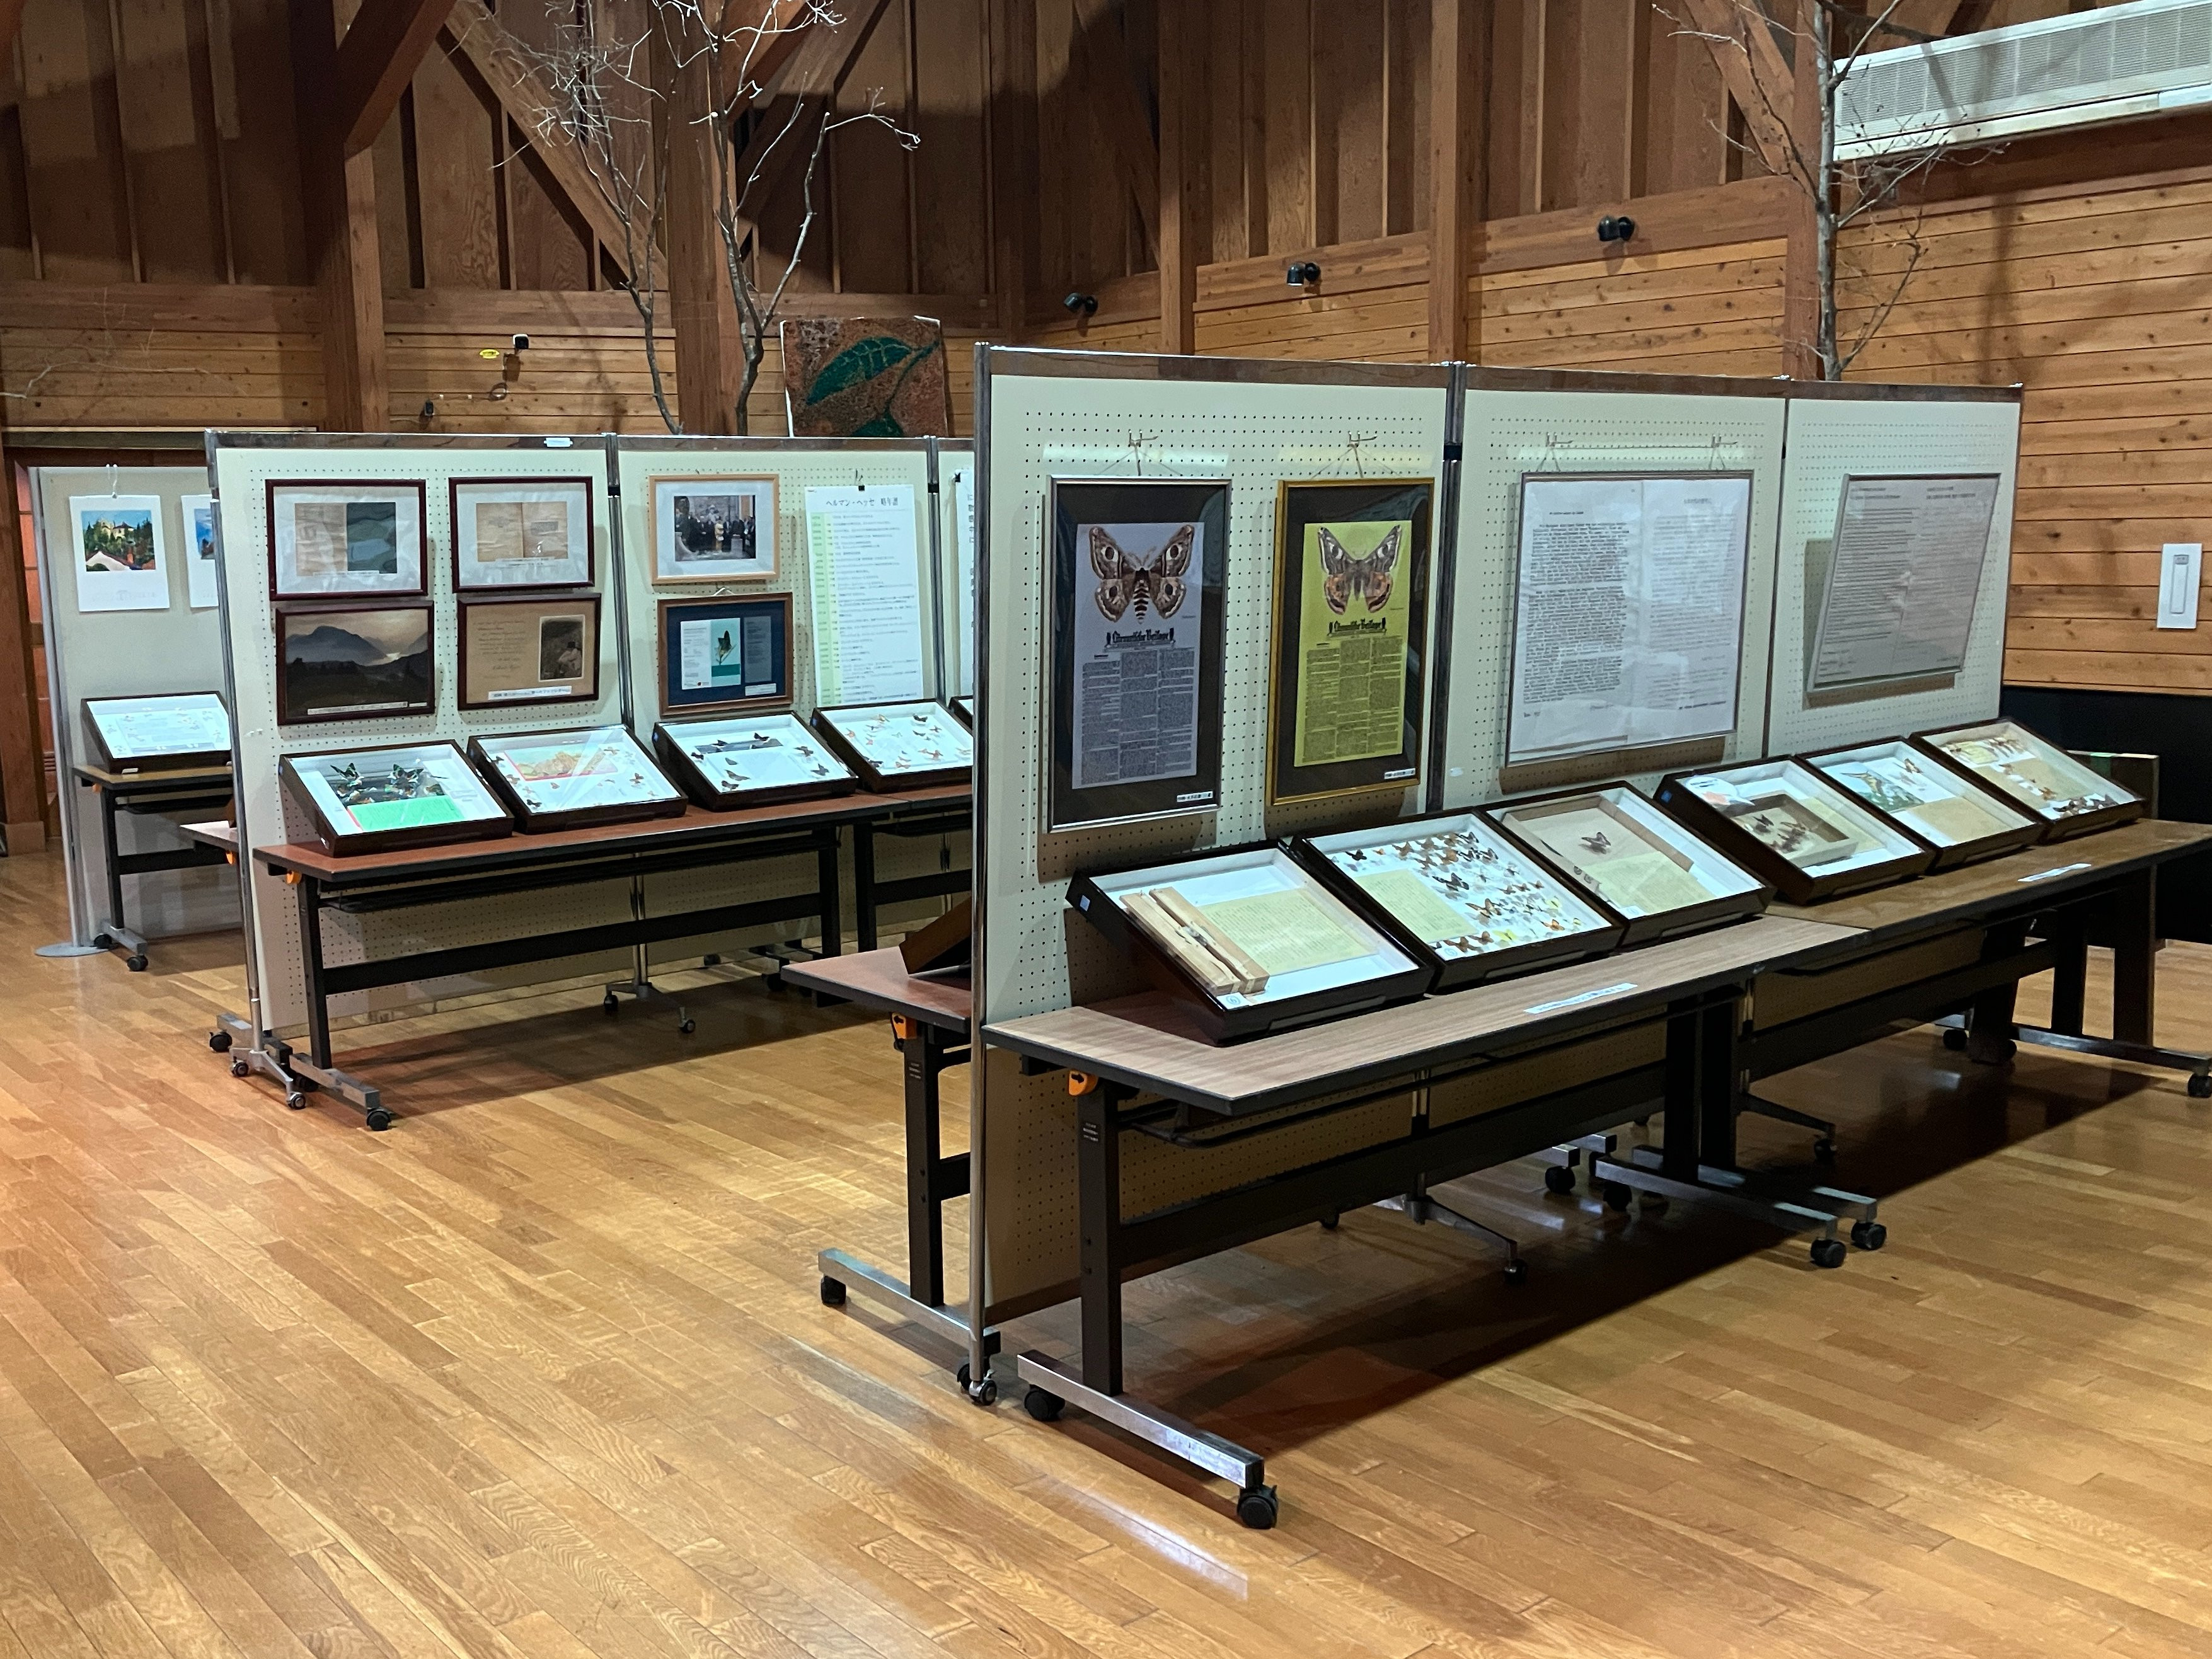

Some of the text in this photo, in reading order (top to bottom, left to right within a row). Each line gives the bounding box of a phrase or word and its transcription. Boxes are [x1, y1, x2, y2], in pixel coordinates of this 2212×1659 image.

[826, 498, 875, 507] ヘルマン・ヘッセ
